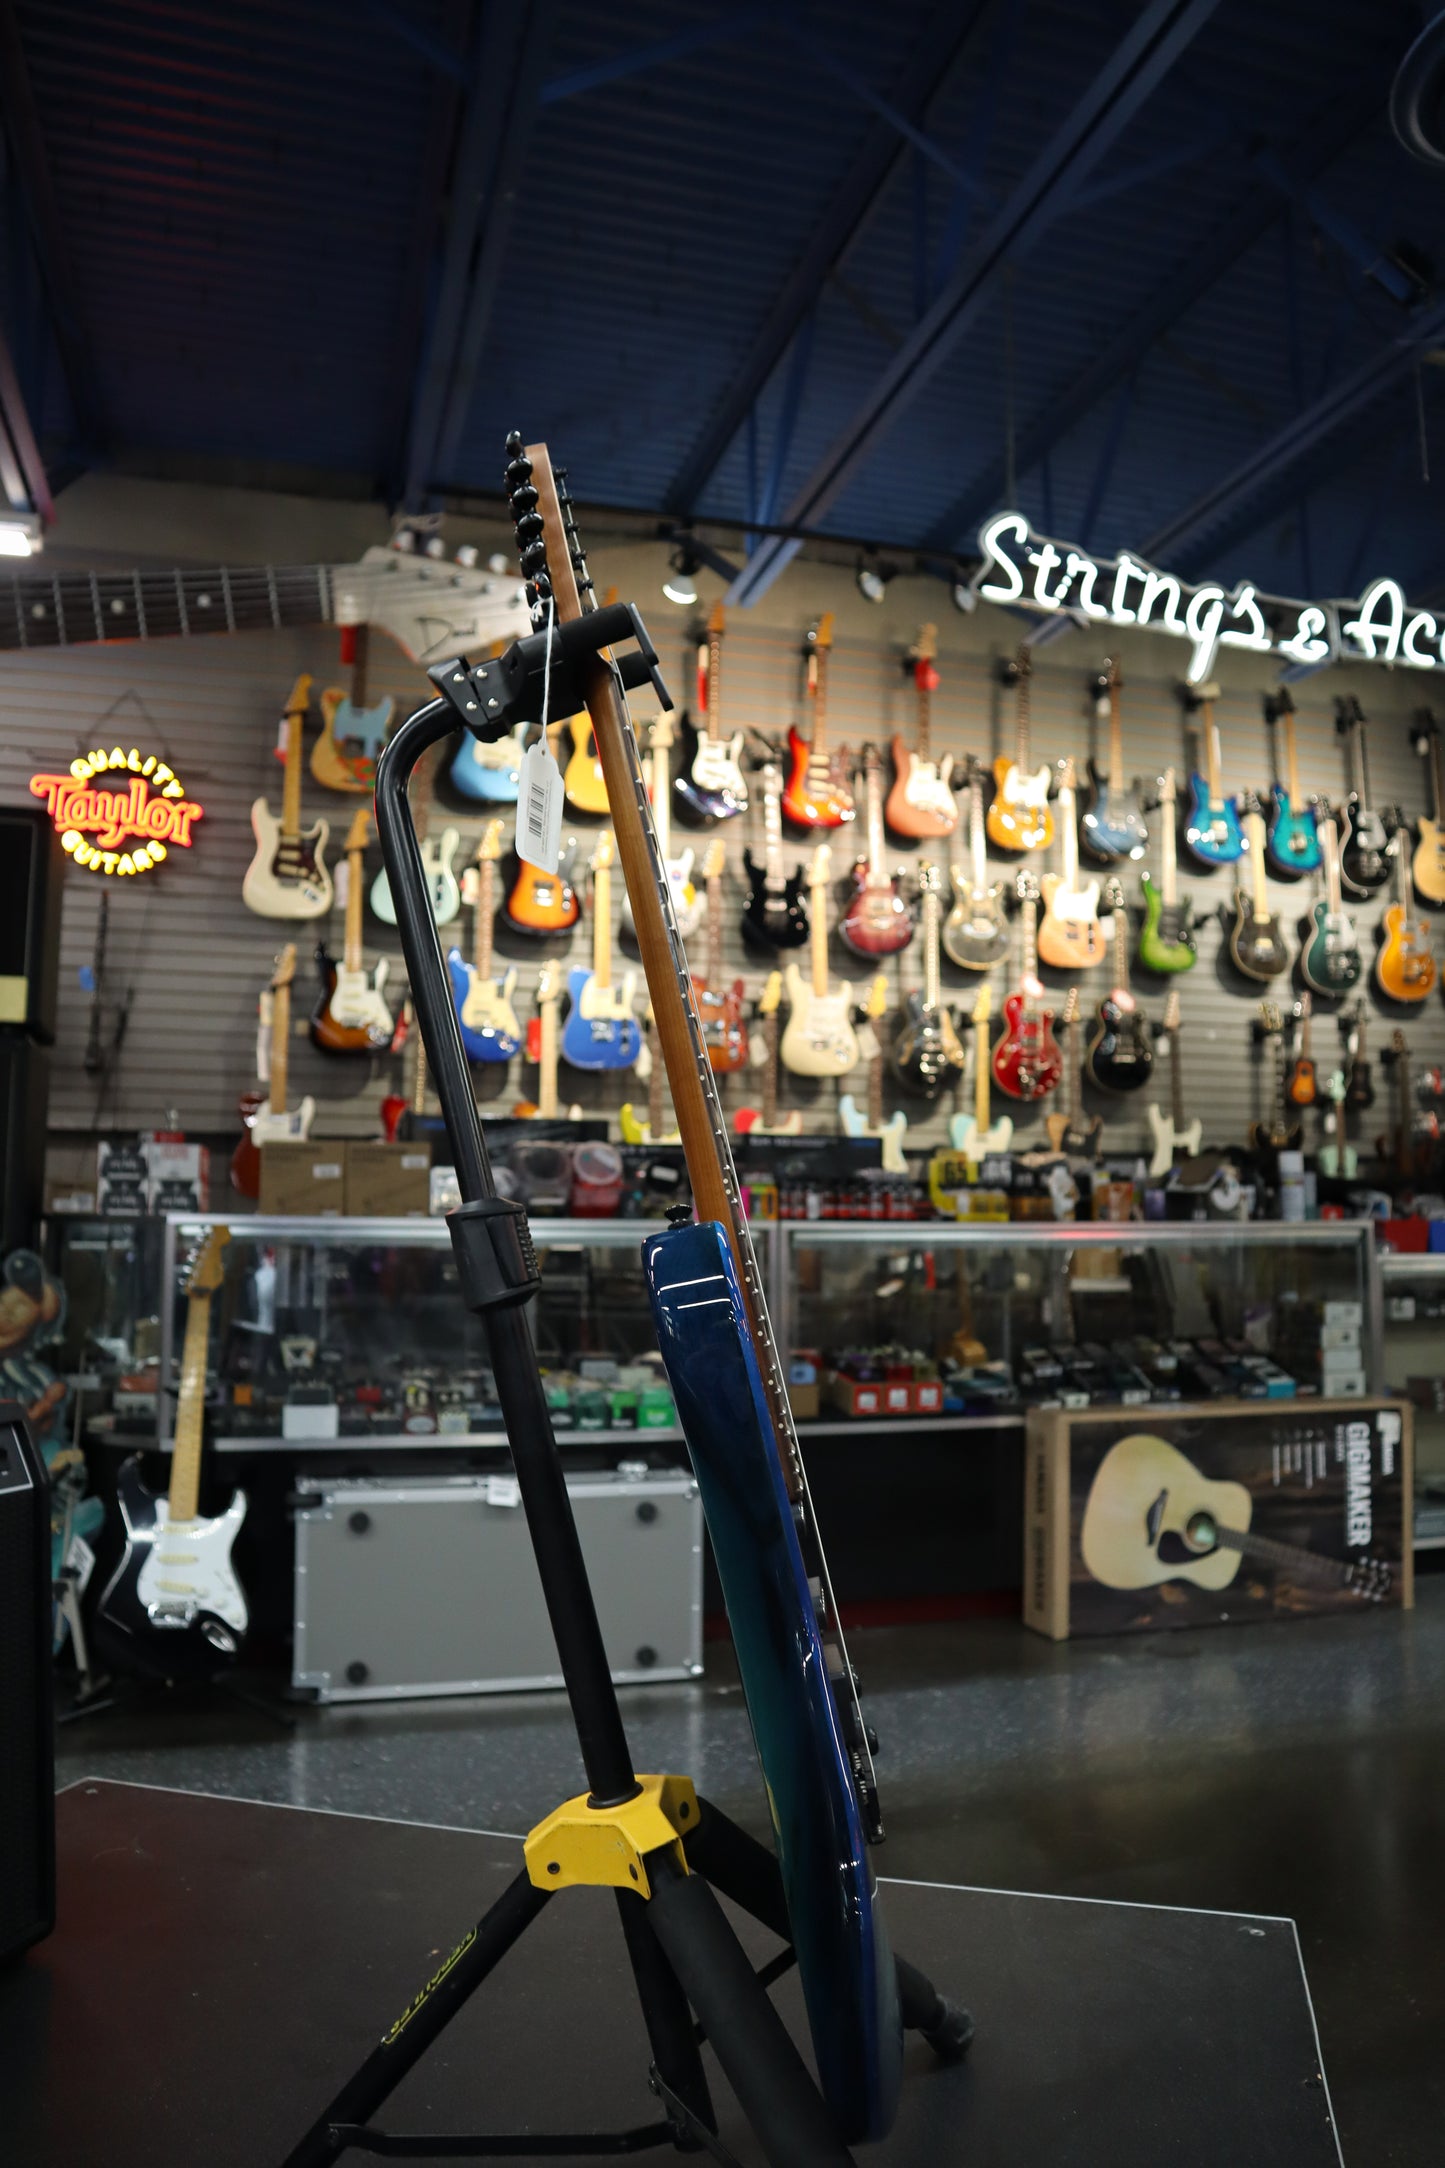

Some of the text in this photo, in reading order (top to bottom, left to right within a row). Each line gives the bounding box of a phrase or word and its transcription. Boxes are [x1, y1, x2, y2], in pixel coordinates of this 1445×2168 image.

[981, 514, 1445, 682] Strings & Ac
[70, 746, 184, 798] QUALITY
[30, 774, 204, 848] Taylor
[61, 829, 167, 876] GUITARS
[1347, 1422, 1371, 1547] GIGMAKER
